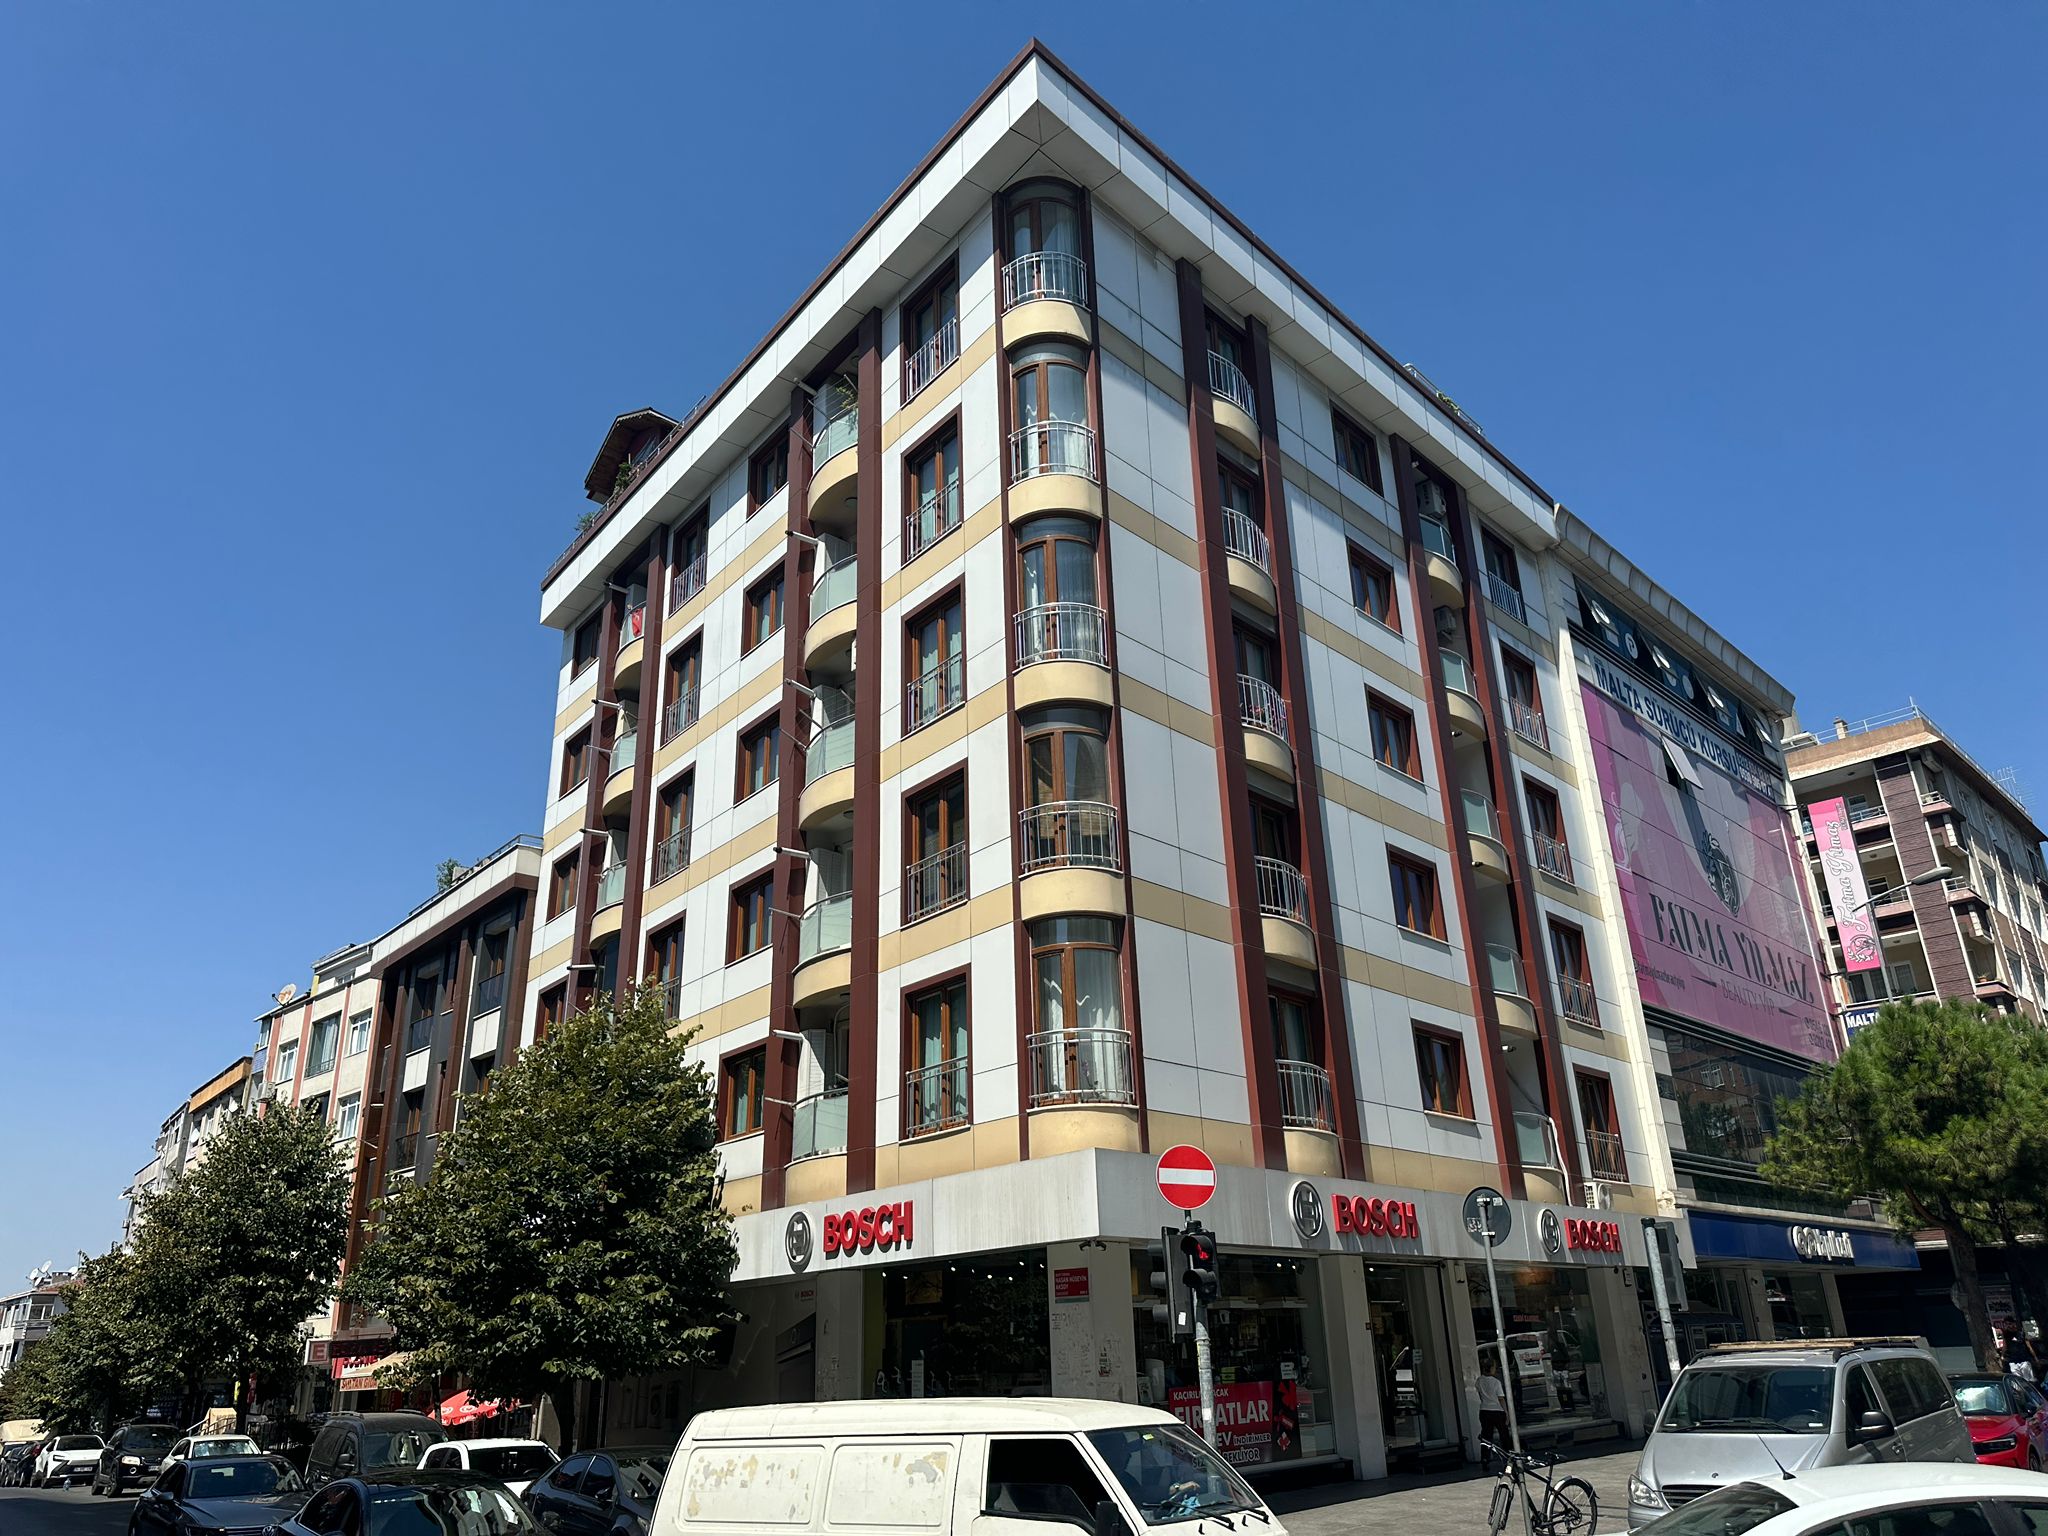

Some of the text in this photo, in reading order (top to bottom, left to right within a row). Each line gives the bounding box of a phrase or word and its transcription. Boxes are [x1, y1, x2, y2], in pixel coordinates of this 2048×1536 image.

[1594, 663, 1644, 714] MALTA
[1643, 694, 1697, 748] SÜRÜCÜ
[1698, 733, 1738, 776] KURSU
[1837, 877, 1868, 932] Fatma
[1649, 892, 1815, 1004] FATMA YILMAZ
[1720, 978, 1759, 1010] BEAUTY
[824, 1200, 913, 1253] BOSCH
[1332, 1194, 1418, 1238] BOSCH
[1563, 1218, 1623, 1252] BOSCH
[314, 1344, 326, 1359] E
[1174, 1399, 1270, 1429] FIRATLAR
